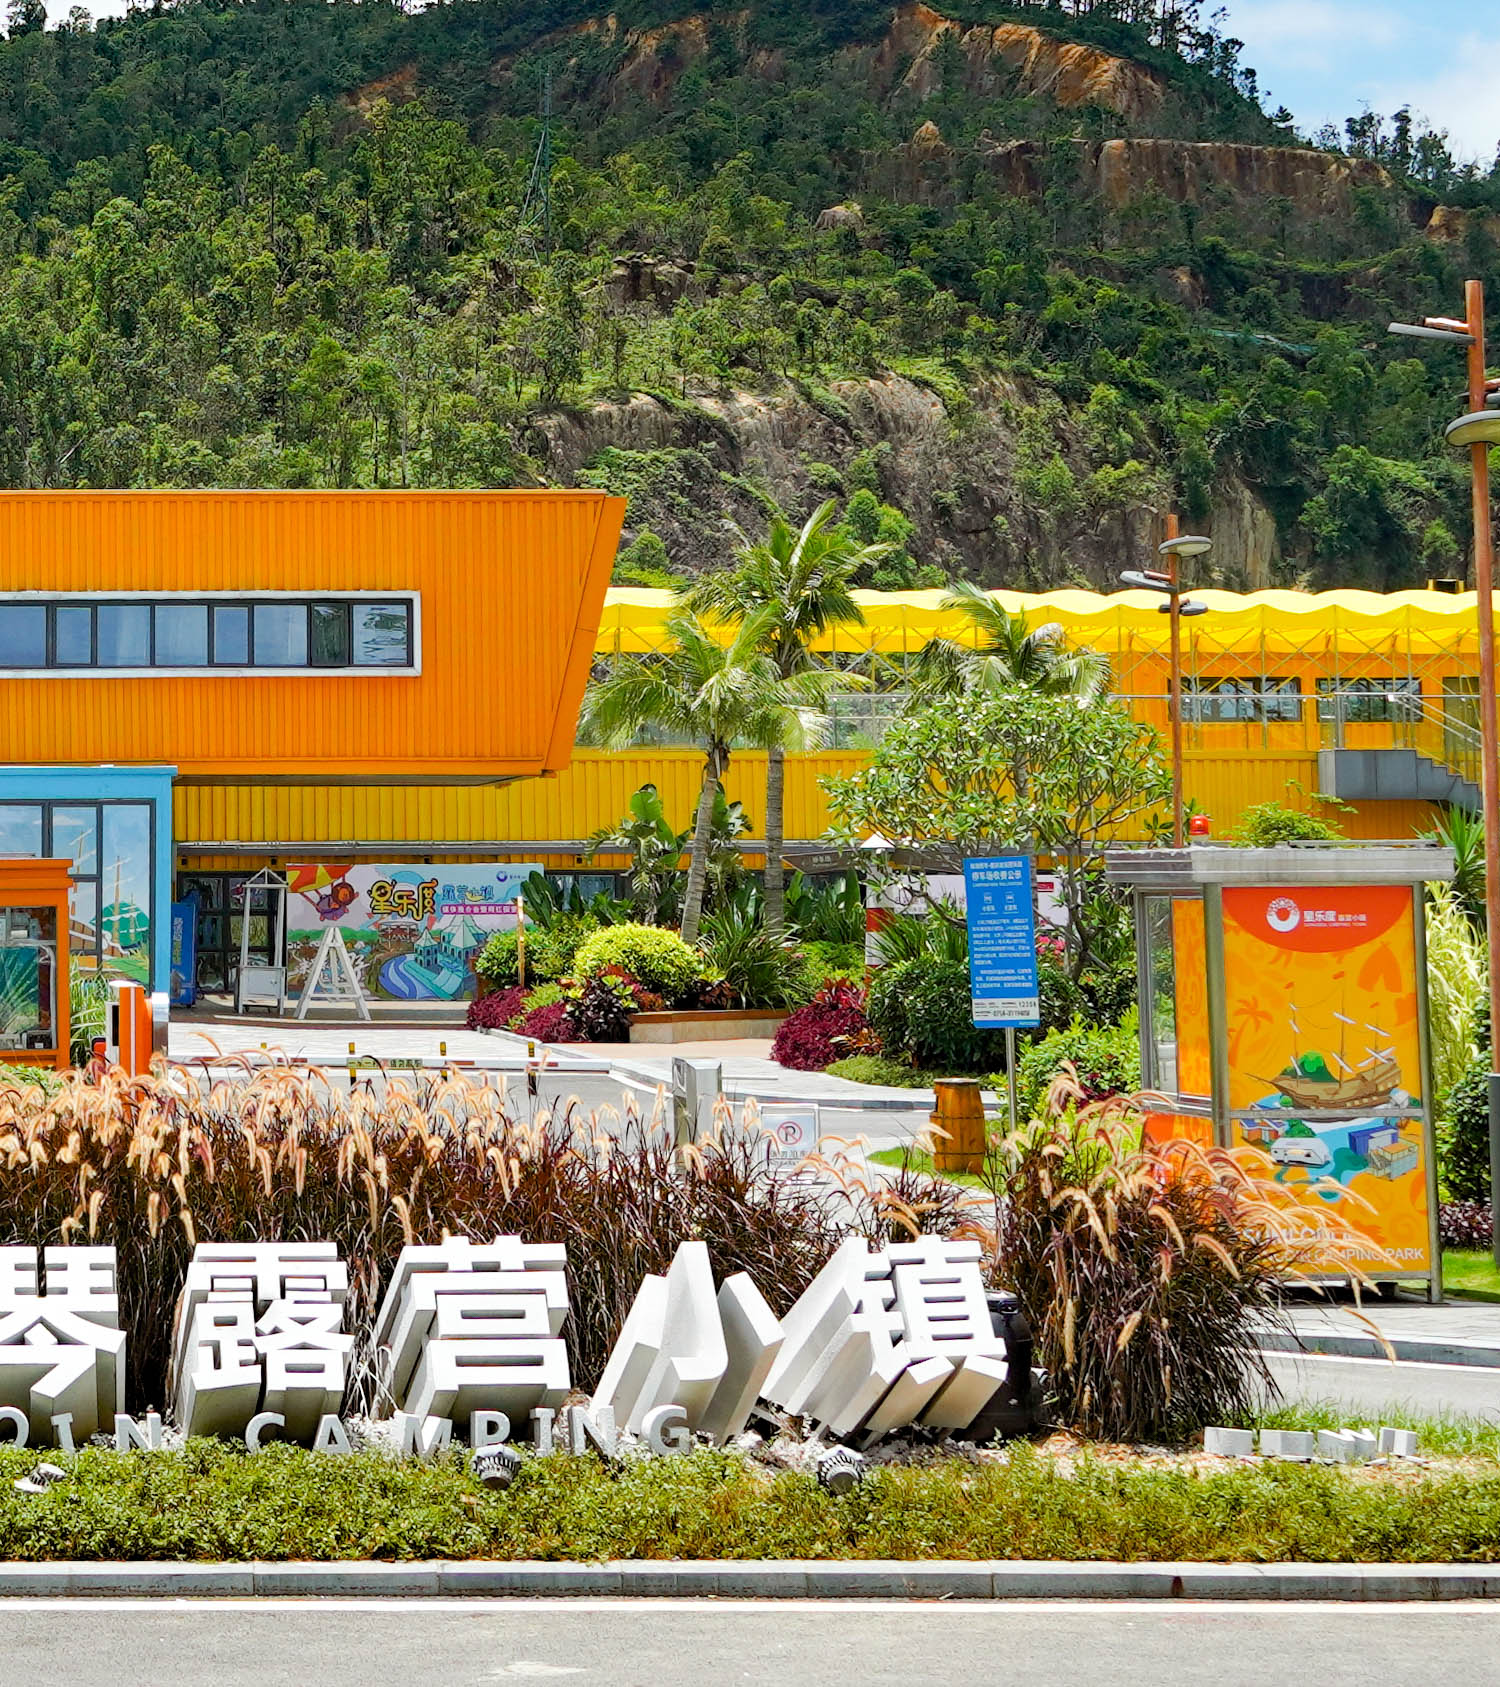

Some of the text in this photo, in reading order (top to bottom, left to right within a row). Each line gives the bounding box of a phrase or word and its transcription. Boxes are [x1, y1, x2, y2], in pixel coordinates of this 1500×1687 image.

[369, 878, 438, 921] 星乐度
[1304, 910, 1336, 922] 星乐度
[1384, 1247, 1425, 1260] PARK
[244, 1403, 691, 1457] CAMPING
